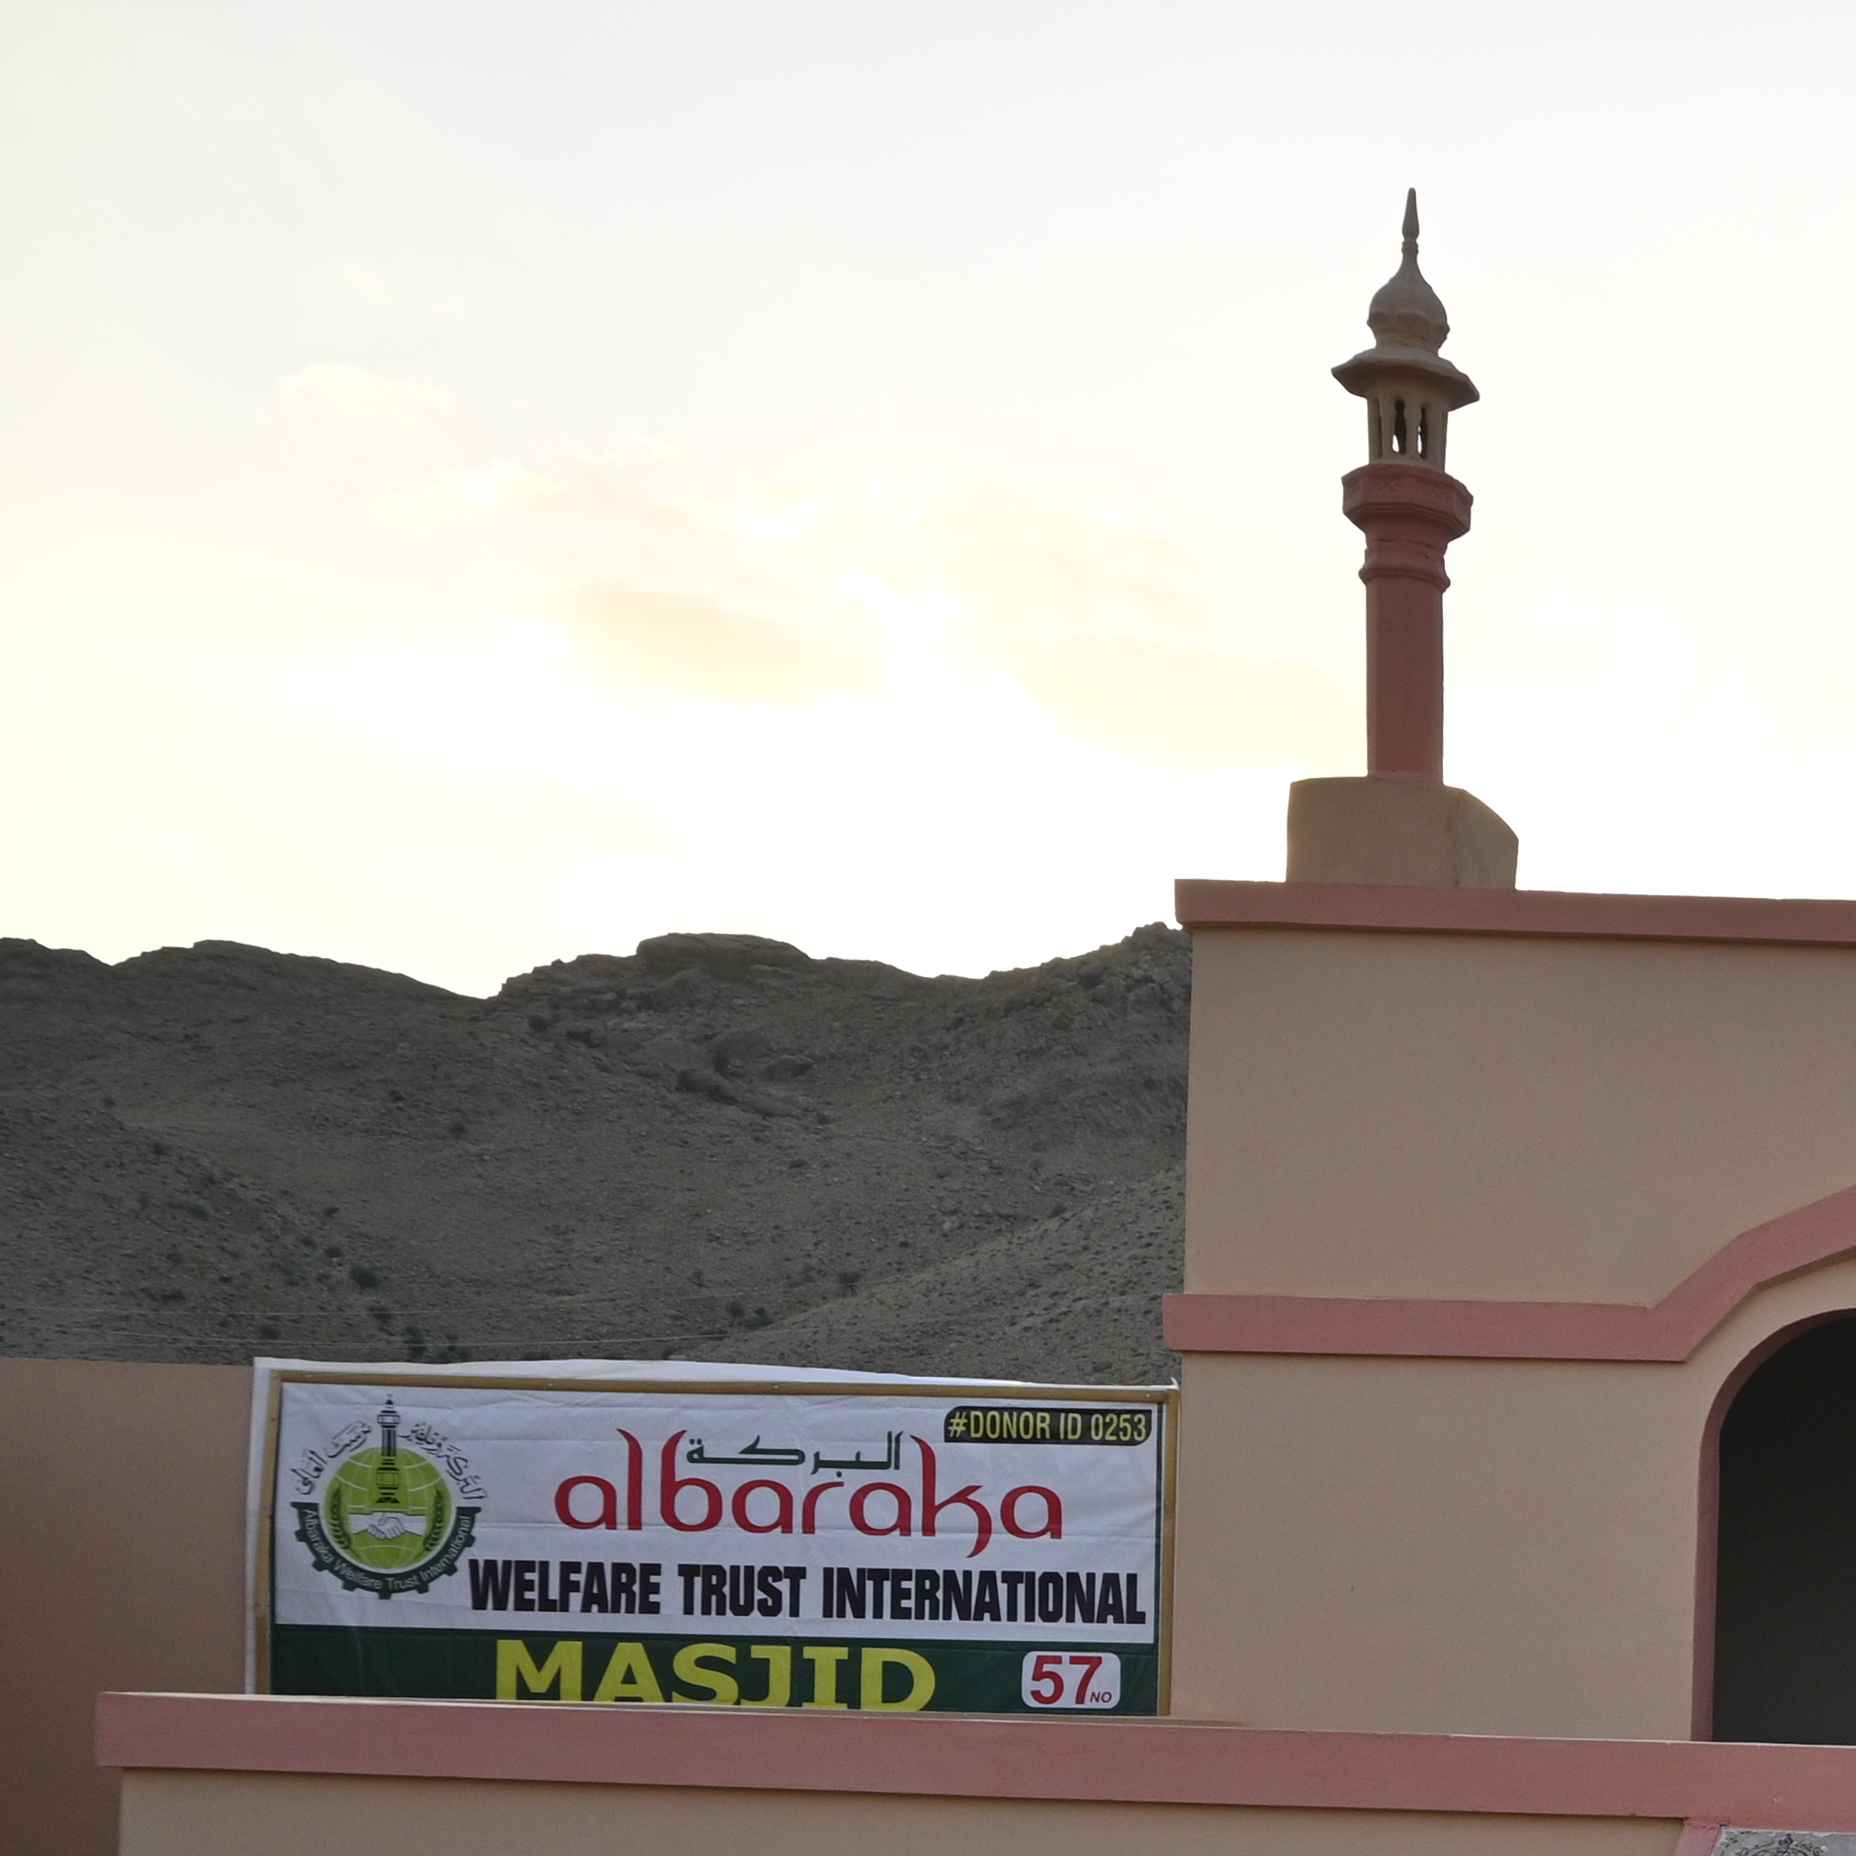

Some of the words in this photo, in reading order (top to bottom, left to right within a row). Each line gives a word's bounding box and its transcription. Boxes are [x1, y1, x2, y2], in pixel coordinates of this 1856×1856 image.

[949, 1410, 1050, 1439] #DONOR
[1060, 1414, 1082, 1440] ID
[1091, 1414, 1147, 1441] 0253
[554, 1428, 1063, 1559] albaraka
[468, 1558, 662, 1615] WELFARE
[677, 1563, 807, 1618] TRUST
[821, 1566, 1146, 1625] INTERNATIONAL
[496, 1639, 936, 1712] MASJID
[1031, 1655, 1103, 1705] 57
